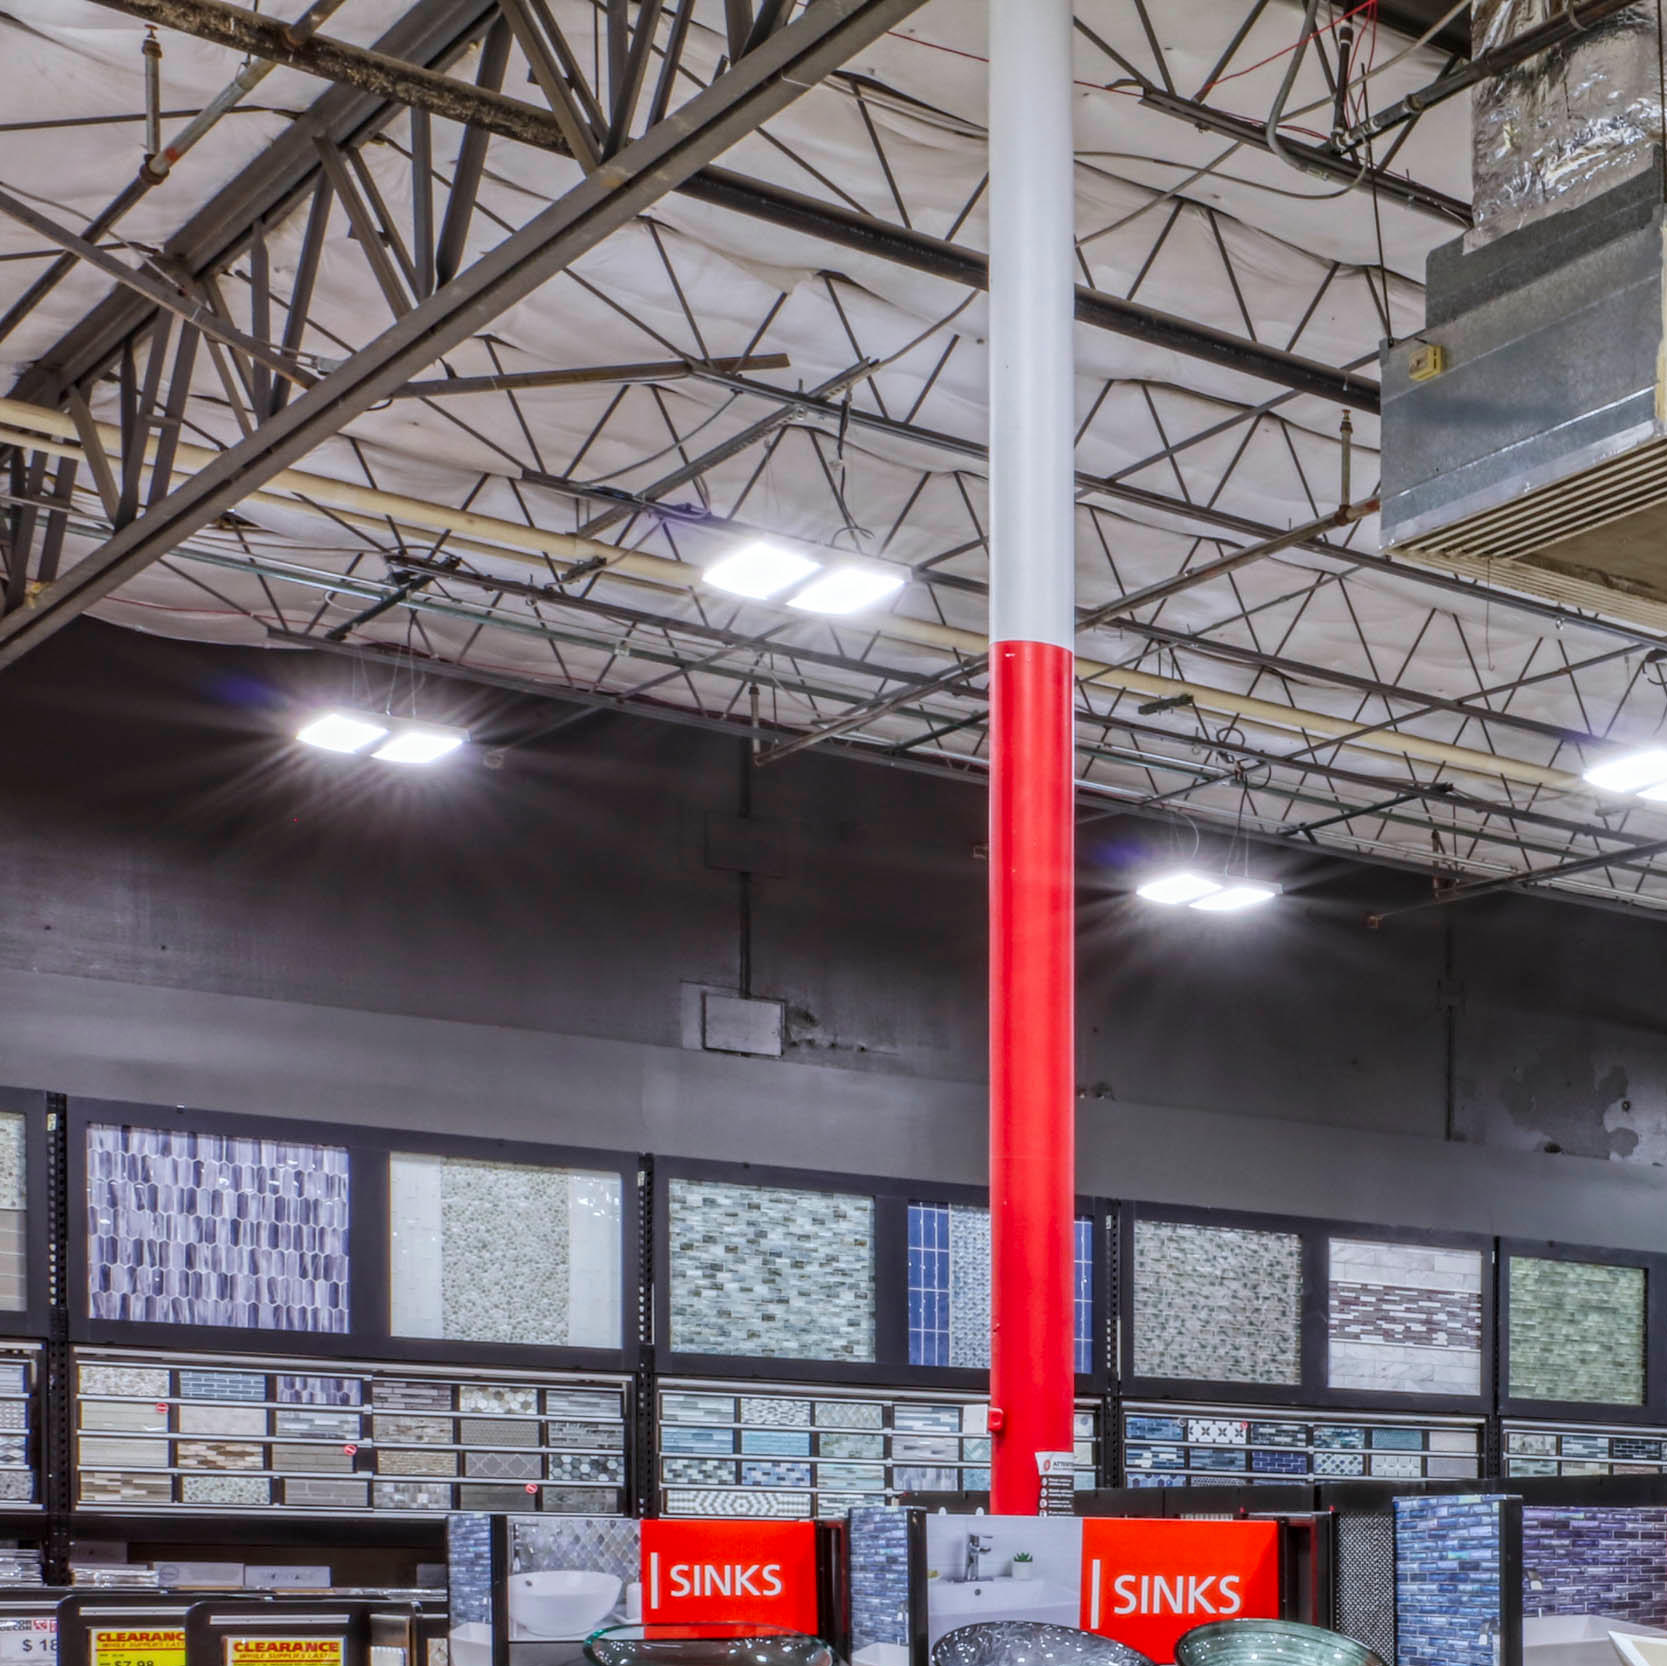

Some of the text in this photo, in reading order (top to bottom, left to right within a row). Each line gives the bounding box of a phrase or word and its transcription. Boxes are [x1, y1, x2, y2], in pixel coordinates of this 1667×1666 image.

[669, 1563, 782, 1597] SINKS
[1113, 1575, 1241, 1615] SINKS
[97, 1632, 185, 1642] CLEARANC
[23, 1639, 32, 1652] $
[233, 1642, 339, 1652] CLEARANCE
